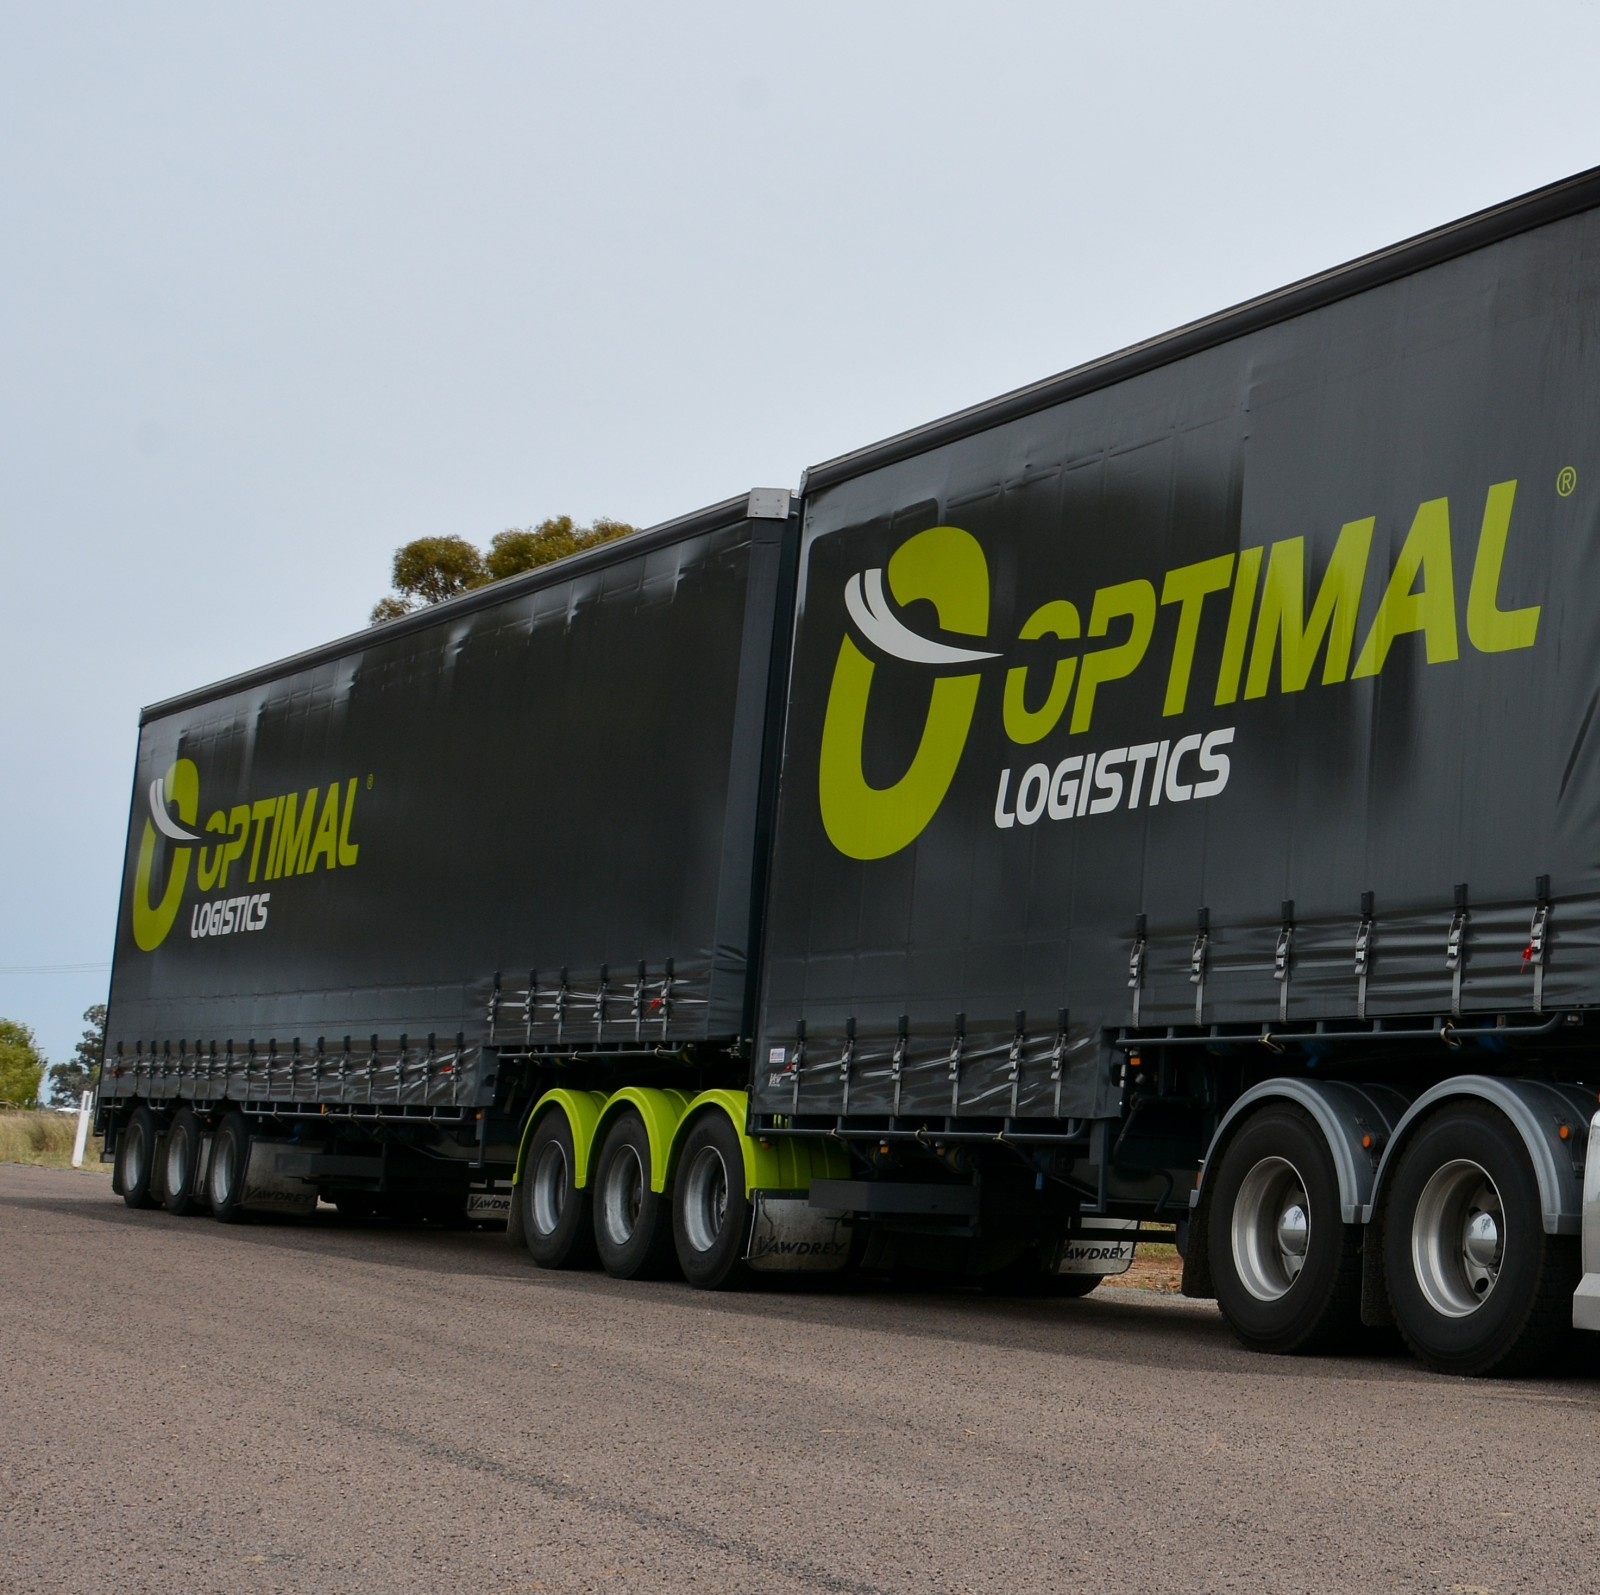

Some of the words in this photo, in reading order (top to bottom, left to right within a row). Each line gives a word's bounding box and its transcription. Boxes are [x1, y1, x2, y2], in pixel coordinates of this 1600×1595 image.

[1002, 479, 1541, 745] OPTIMAL
[994, 727, 1236, 829] LOGISTICS
[197, 777, 359, 892] OPTIMAL
[190, 893, 271, 939] LOGISTICS
[244, 1185, 314, 1203] VAWDREY
[469, 1196, 511, 1212] VAWDR
[757, 1236, 847, 1256] VAWDREY
[1064, 1246, 1130, 1260] AWDREY
